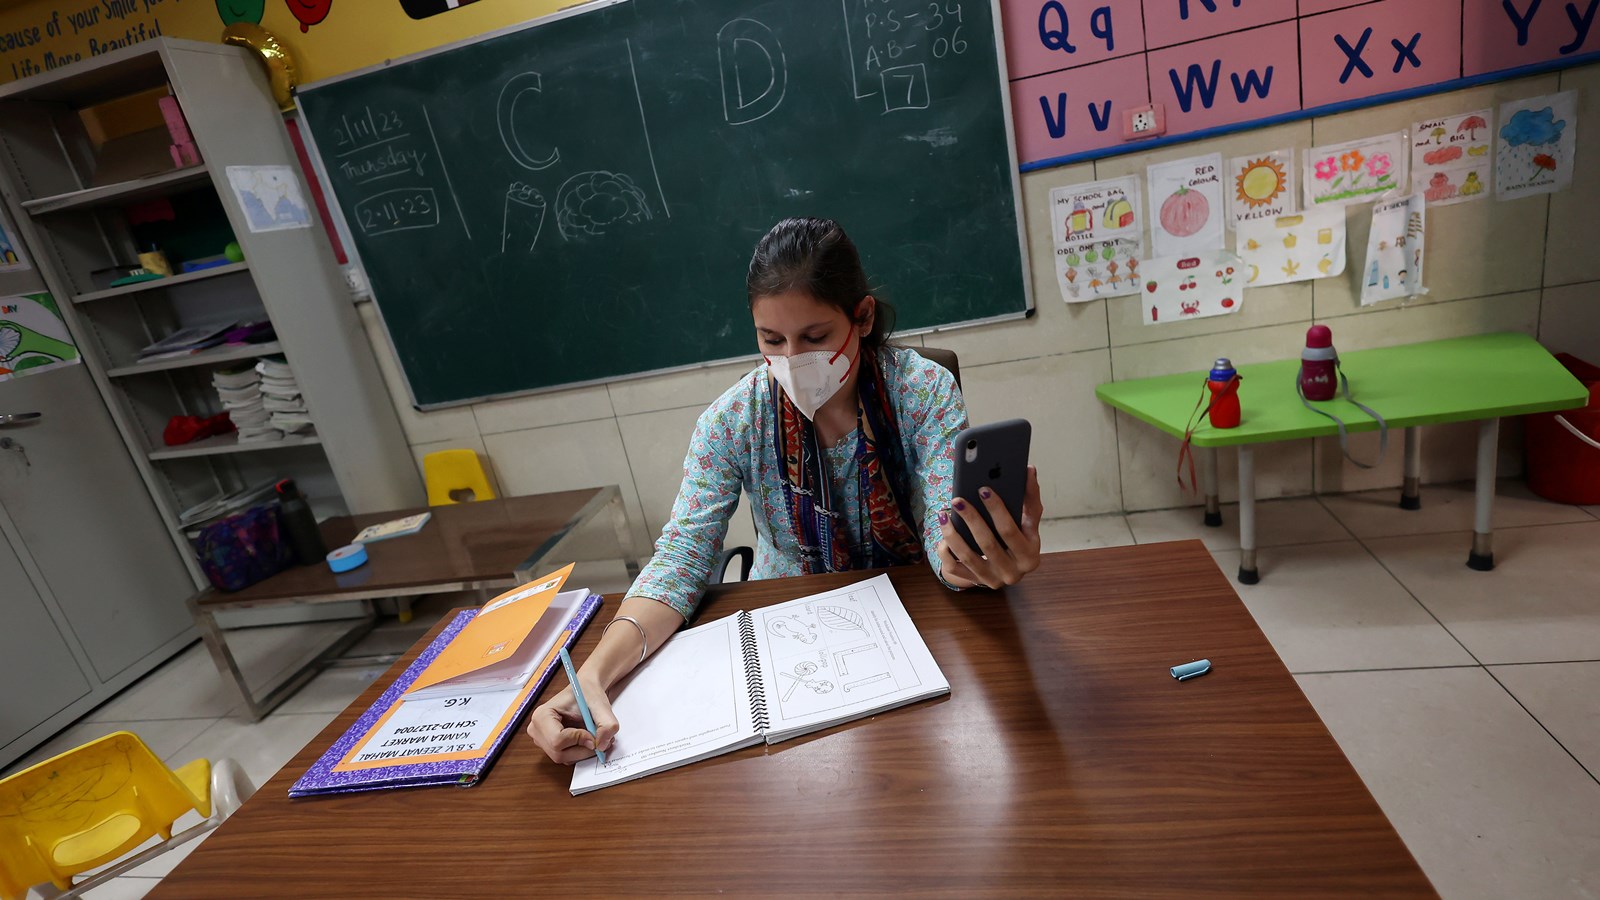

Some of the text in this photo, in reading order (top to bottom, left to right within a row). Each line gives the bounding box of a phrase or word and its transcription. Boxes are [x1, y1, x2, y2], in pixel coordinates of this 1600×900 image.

[46, 11, 61, 37] of
[68, 5, 100, 34] your
[924, 0, 963, 30] 34
[1038, 1, 1114, 54] Q q
[1502, 0, 1600, 55] Y y
[932, 25, 968, 58] 06
[1333, 27, 1422, 84] X x
[717, 18, 787, 125] D
[1168, 59, 1274, 113] W w
[892, 74, 915, 105] 7
[497, 71, 560, 170] C
[1039, 92, 1112, 139] V v
[1450, 134, 1465, 143] BIG
[340, 145, 427, 178] Thursday
[1195, 165, 1215, 175] RED
[1073, 192, 1103, 202] SCHOOL
[1107, 188, 1125, 197] BAG
[1236, 206, 1283, 221] YELLOW
[1057, 239, 1120, 255] ODD ONE OUT
[1065, 233, 1095, 242] BOTTLE
[444, 696, 472, 708] K.G.
[381, 732, 471, 748] KAMLA MARKET
[393, 720, 478, 735] SCH ID-2127004
[359, 743, 476, 762] S.B.V. ZEENAT MAHAL
